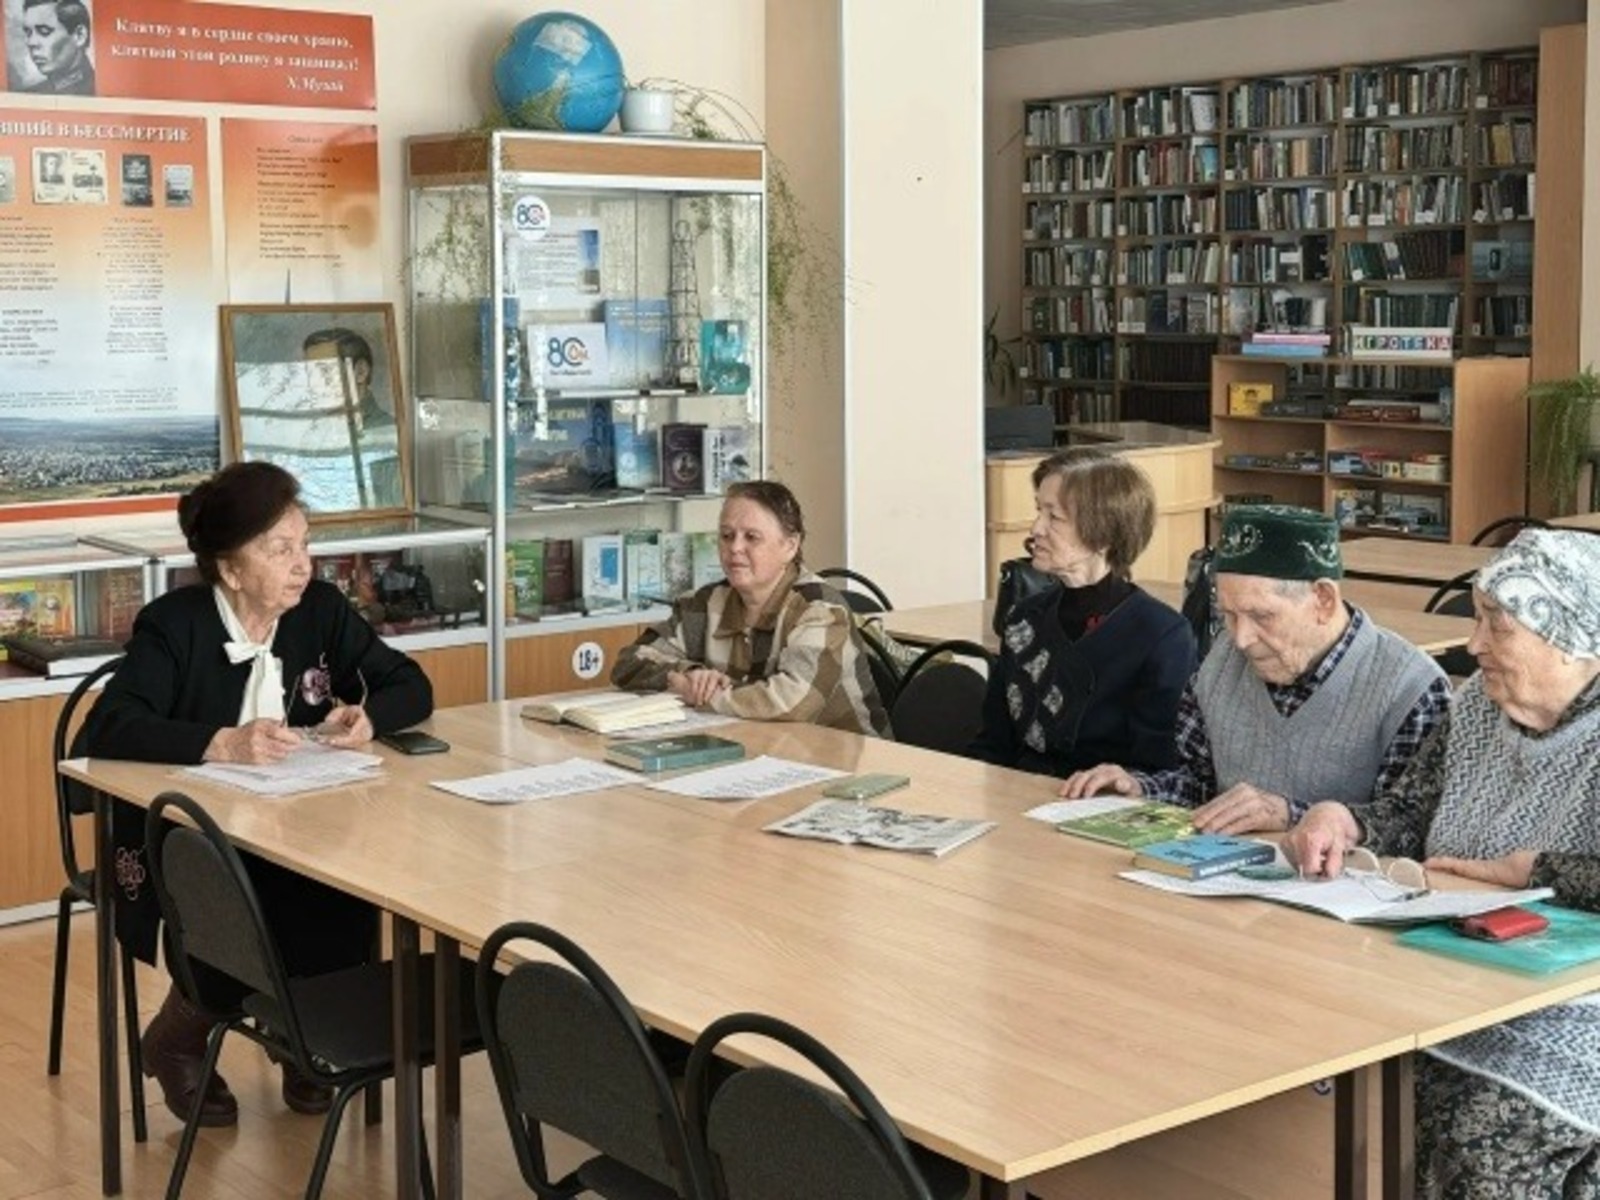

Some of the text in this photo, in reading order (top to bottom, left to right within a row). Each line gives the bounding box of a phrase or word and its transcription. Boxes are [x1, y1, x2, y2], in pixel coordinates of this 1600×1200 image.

[115, 17, 172, 38] Клятву
[204, 28, 253, 43] сердце
[218, 52, 269, 68] родину
[73, 123, 190, 142] БЕССМЕРТИЕ
[1353, 335, 1450, 351] ИГРОТЕКА
[579, 649, 600, 671] 18+
